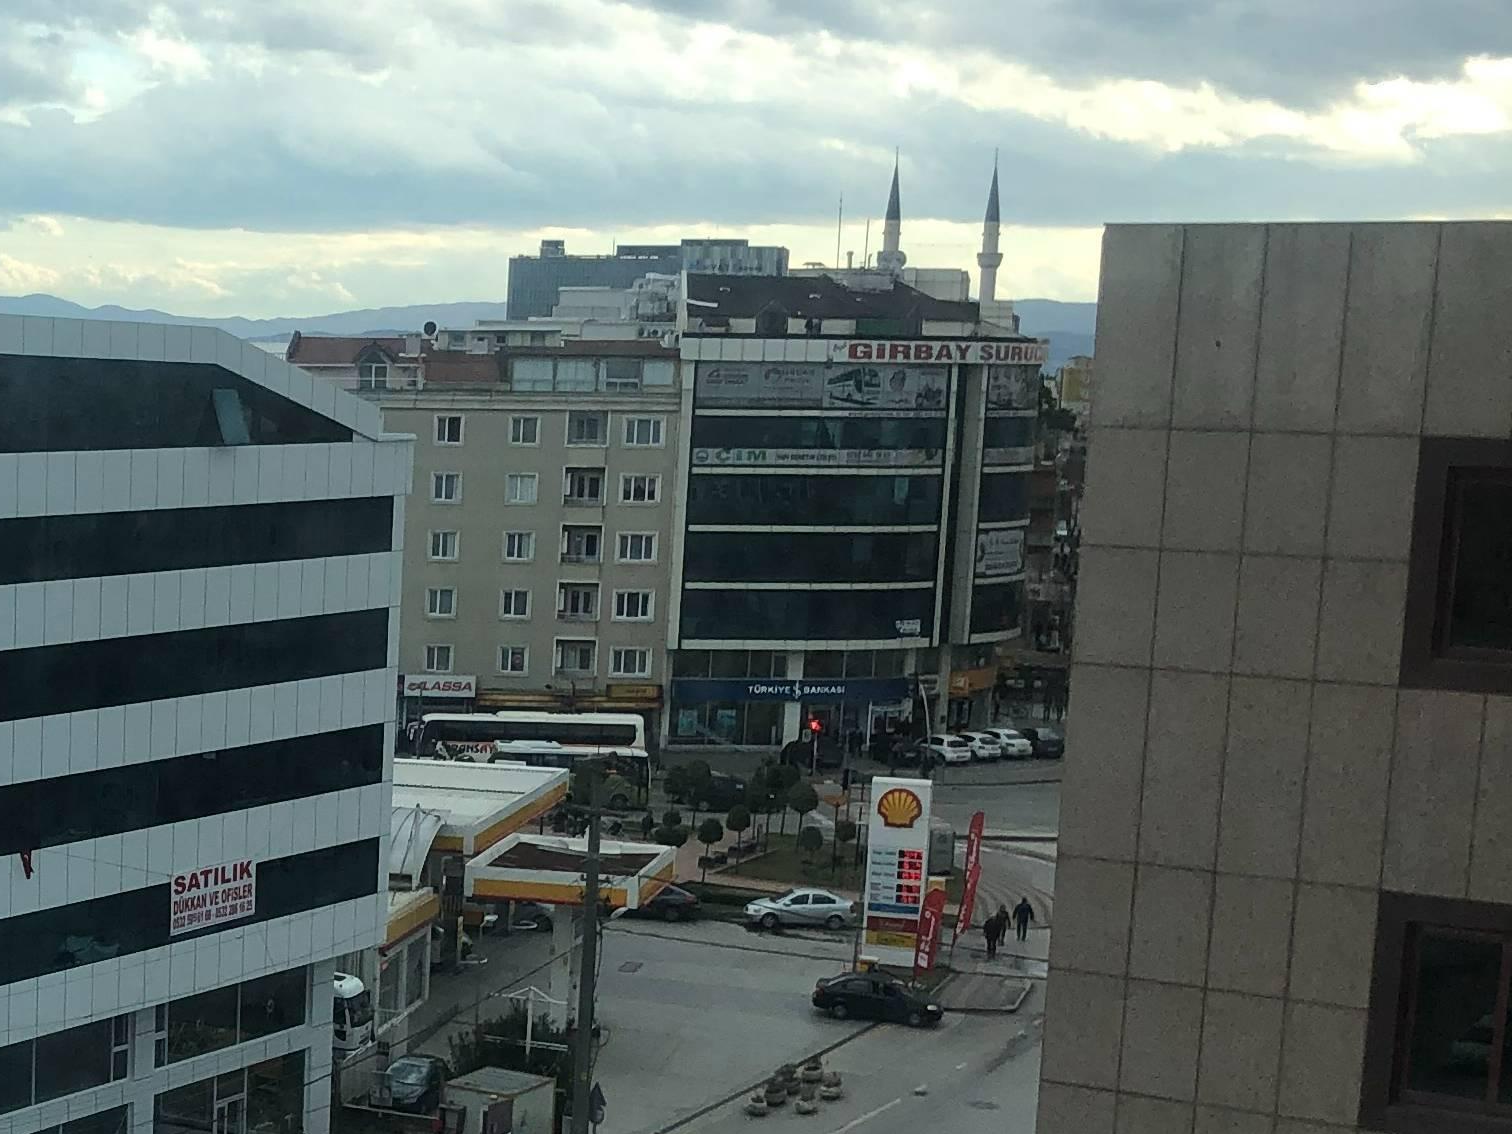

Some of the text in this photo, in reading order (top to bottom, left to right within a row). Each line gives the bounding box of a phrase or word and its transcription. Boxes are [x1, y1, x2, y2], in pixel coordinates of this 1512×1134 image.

[748, 684, 791, 695] TÜRKİYE
[803, 685, 845, 695] BANKASI
[173, 860, 253, 895] SATILIK
